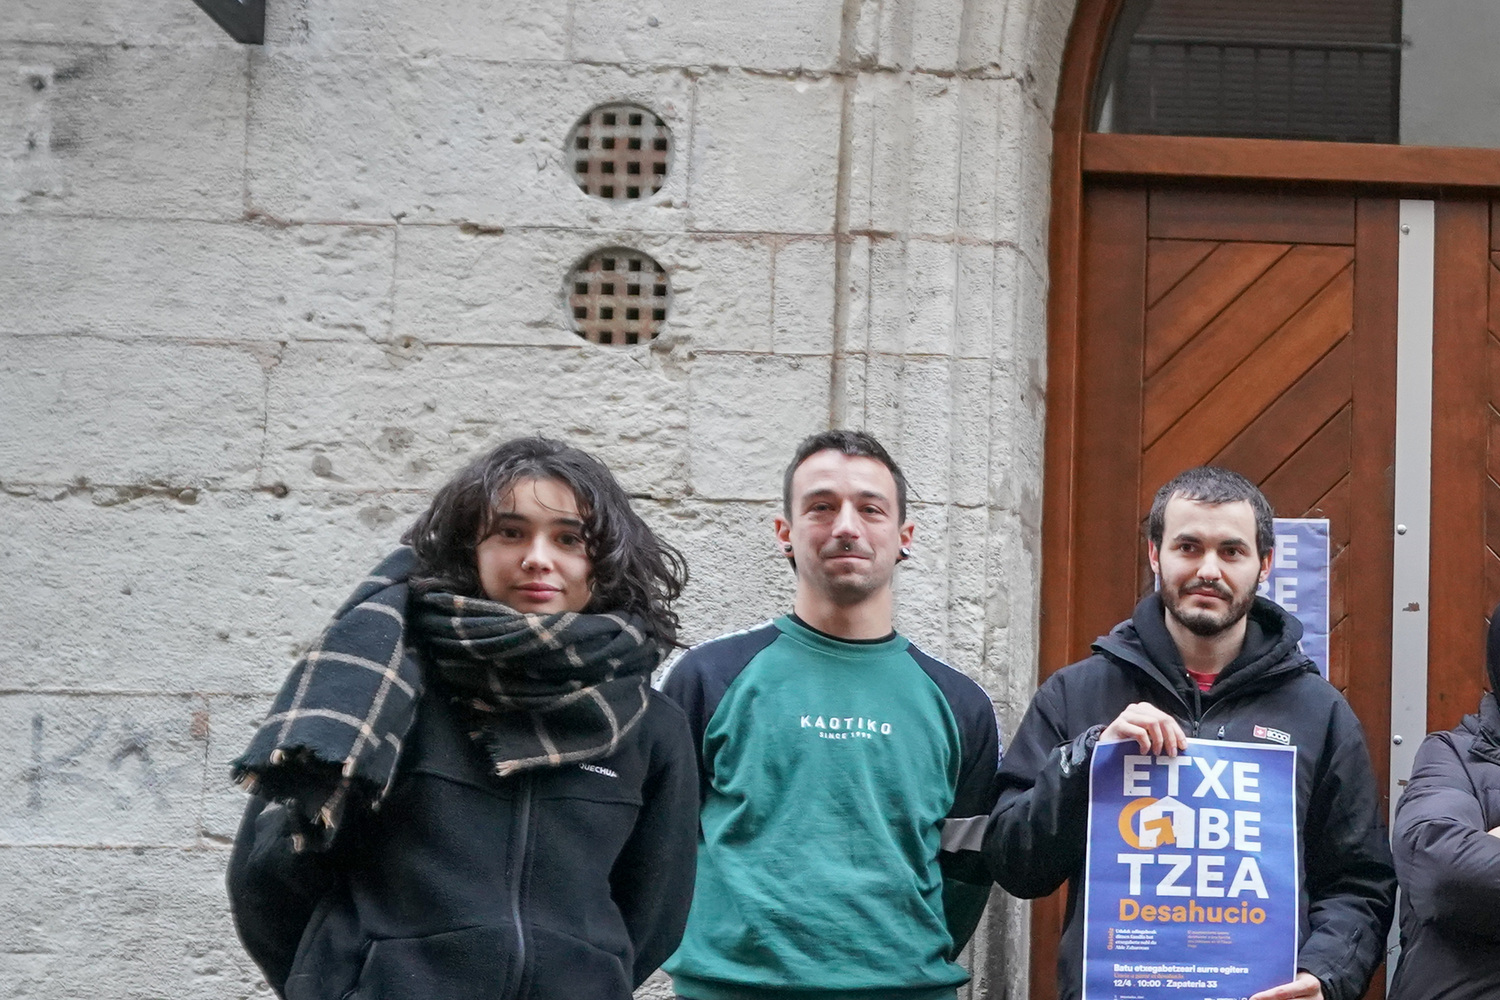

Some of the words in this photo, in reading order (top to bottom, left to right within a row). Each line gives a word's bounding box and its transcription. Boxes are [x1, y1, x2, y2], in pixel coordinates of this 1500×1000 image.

[801, 715, 892, 735] KAOTIKO
[819, 731, 847, 740] SINCE
[579, 762, 618, 778] QUECHUA
[1123, 755, 1261, 803] ETXE
[1118, 796, 1262, 852] GABE
[1117, 854, 1270, 899] TZEA
[1119, 899, 1267, 925] Desahucio
[1114, 964, 1133, 972] Batu
[1134, 965, 1196, 974] etxegabetzeari
[1220, 966, 1249, 975] egitera
[1113, 979, 1132, 987] 12/4
[1137, 980, 1161, 988] 10:00
[1166, 980, 1206, 989] Zapateria
[1207, 980, 1218, 988] 33
